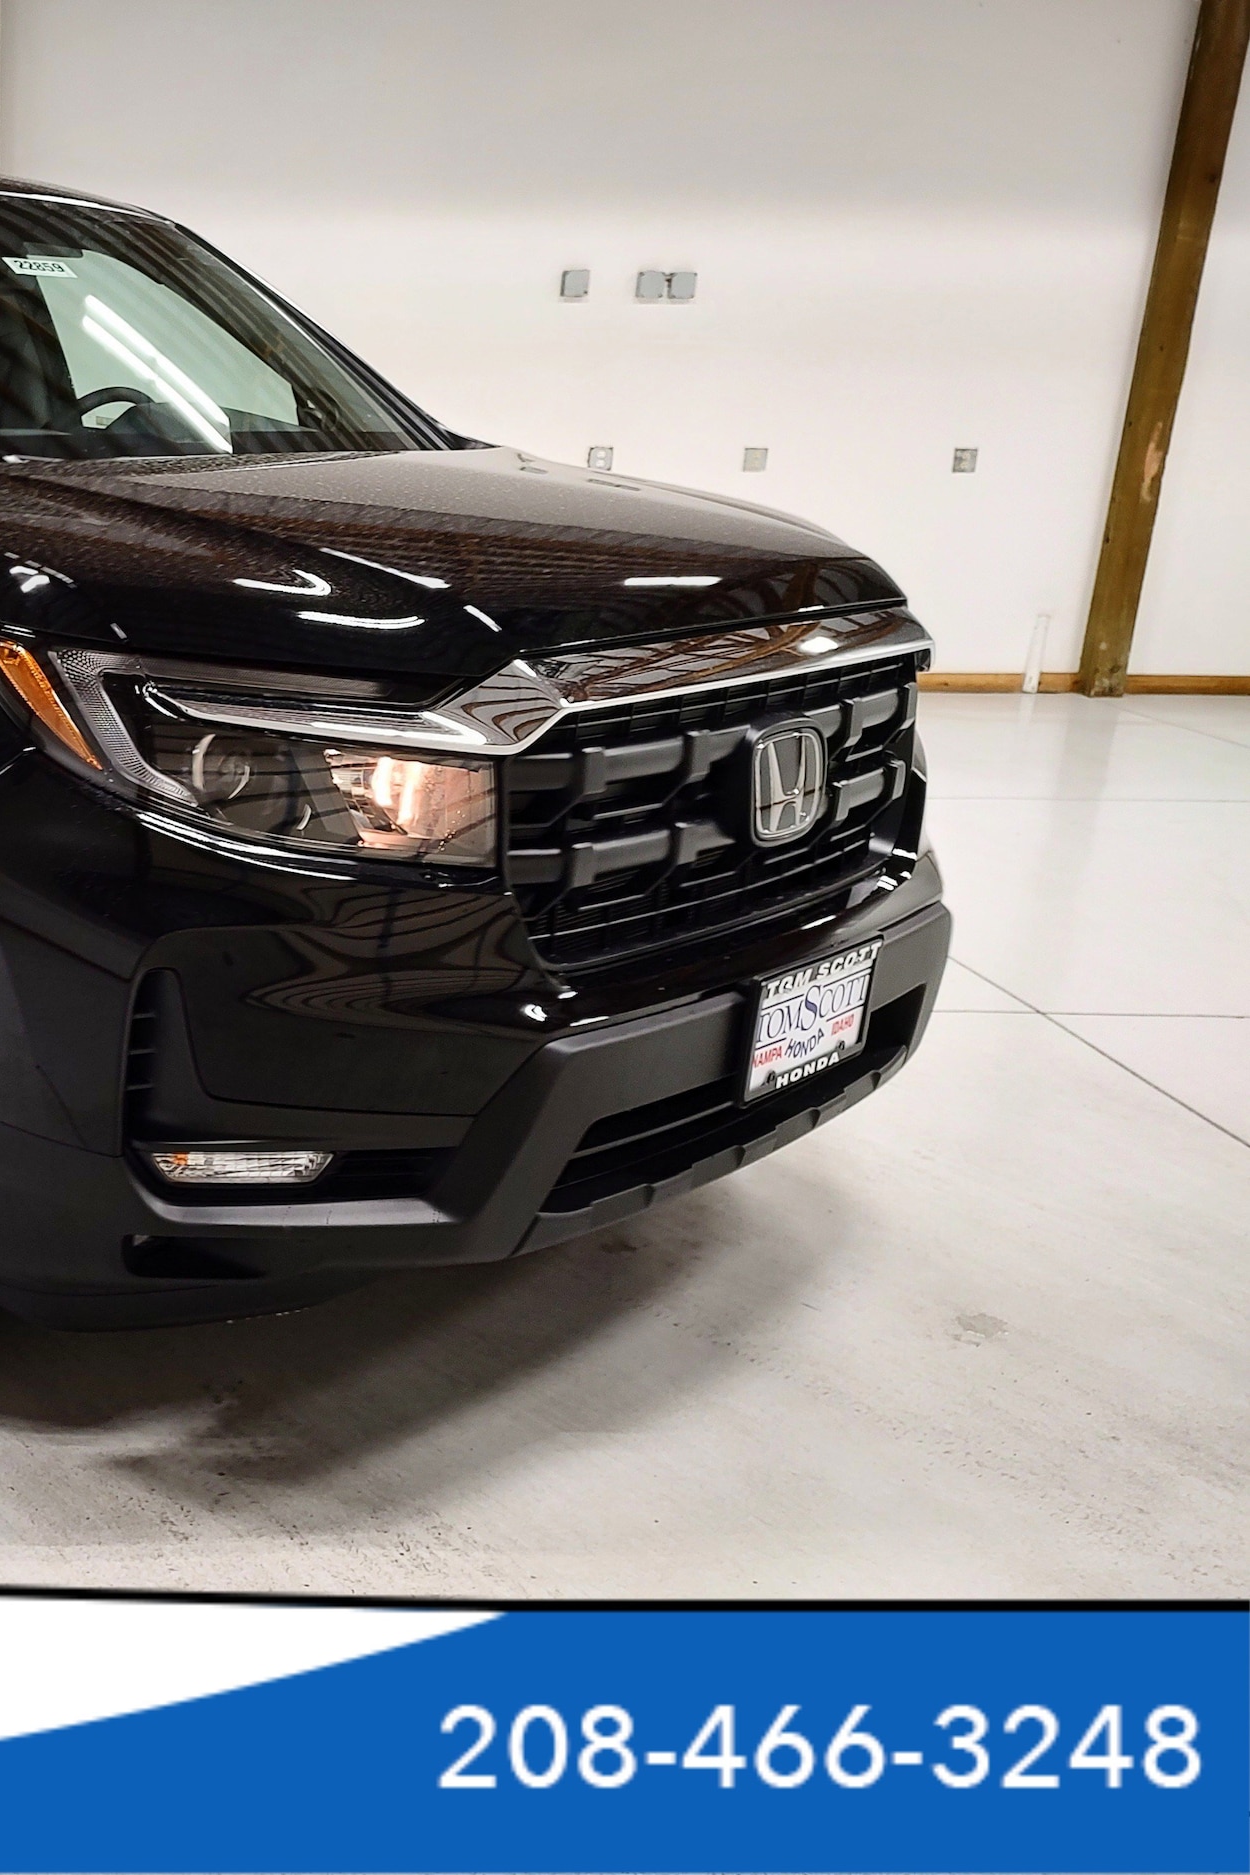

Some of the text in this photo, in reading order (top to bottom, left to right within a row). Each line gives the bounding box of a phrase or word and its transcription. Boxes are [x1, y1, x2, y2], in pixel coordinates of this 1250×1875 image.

[14, 260, 65, 273] 22859
[766, 942, 883, 999] TOM SCOTT
[831, 1014, 855, 1036] IDAHO
[785, 1028, 826, 1058] HONDA
[752, 1046, 783, 1068] NAMPA
[775, 1051, 840, 1089] HONDA
